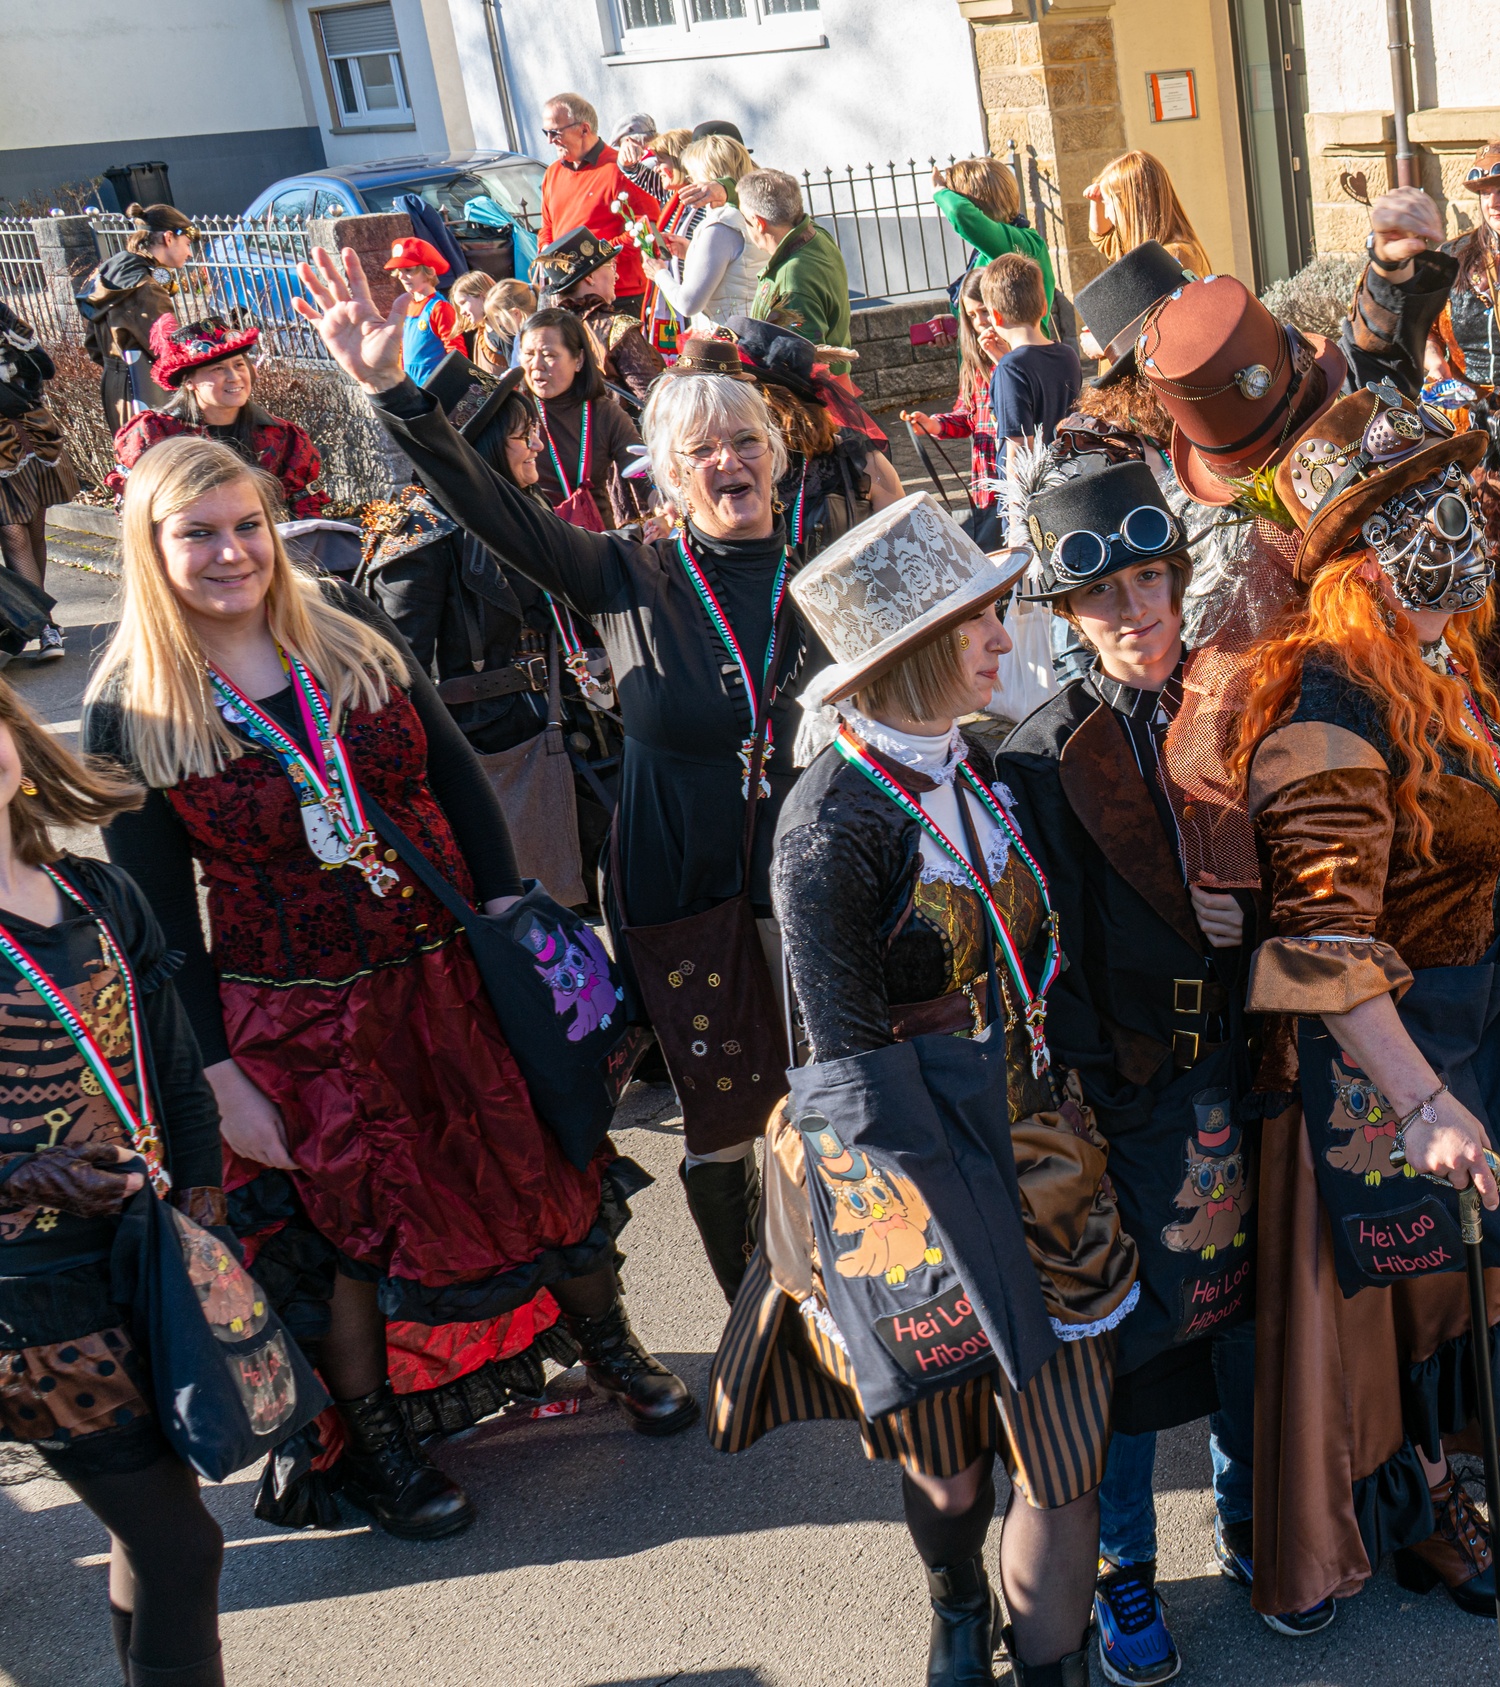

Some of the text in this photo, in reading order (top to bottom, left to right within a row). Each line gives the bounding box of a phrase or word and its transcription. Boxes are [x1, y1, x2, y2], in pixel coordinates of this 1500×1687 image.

[682, 552, 738, 655] Bollonia Hei Loo
[217, 680, 301, 758] Bollonia Hei
[869, 766, 991, 903] Bollonia Hei Loo
[27, 966, 86, 1041] Bollonia
[607, 1043, 629, 1074] Hei
[626, 1026, 642, 1050] Lo
[1360, 1215, 1435, 1247] Hei Loo
[1373, 1246, 1451, 1272] Hiboux
[1191, 1261, 1249, 1303] Hei Loo
[893, 1312, 941, 1342] Hei
[1186, 1293, 1242, 1333] Hiboux
[915, 1328, 990, 1371] Hibou
